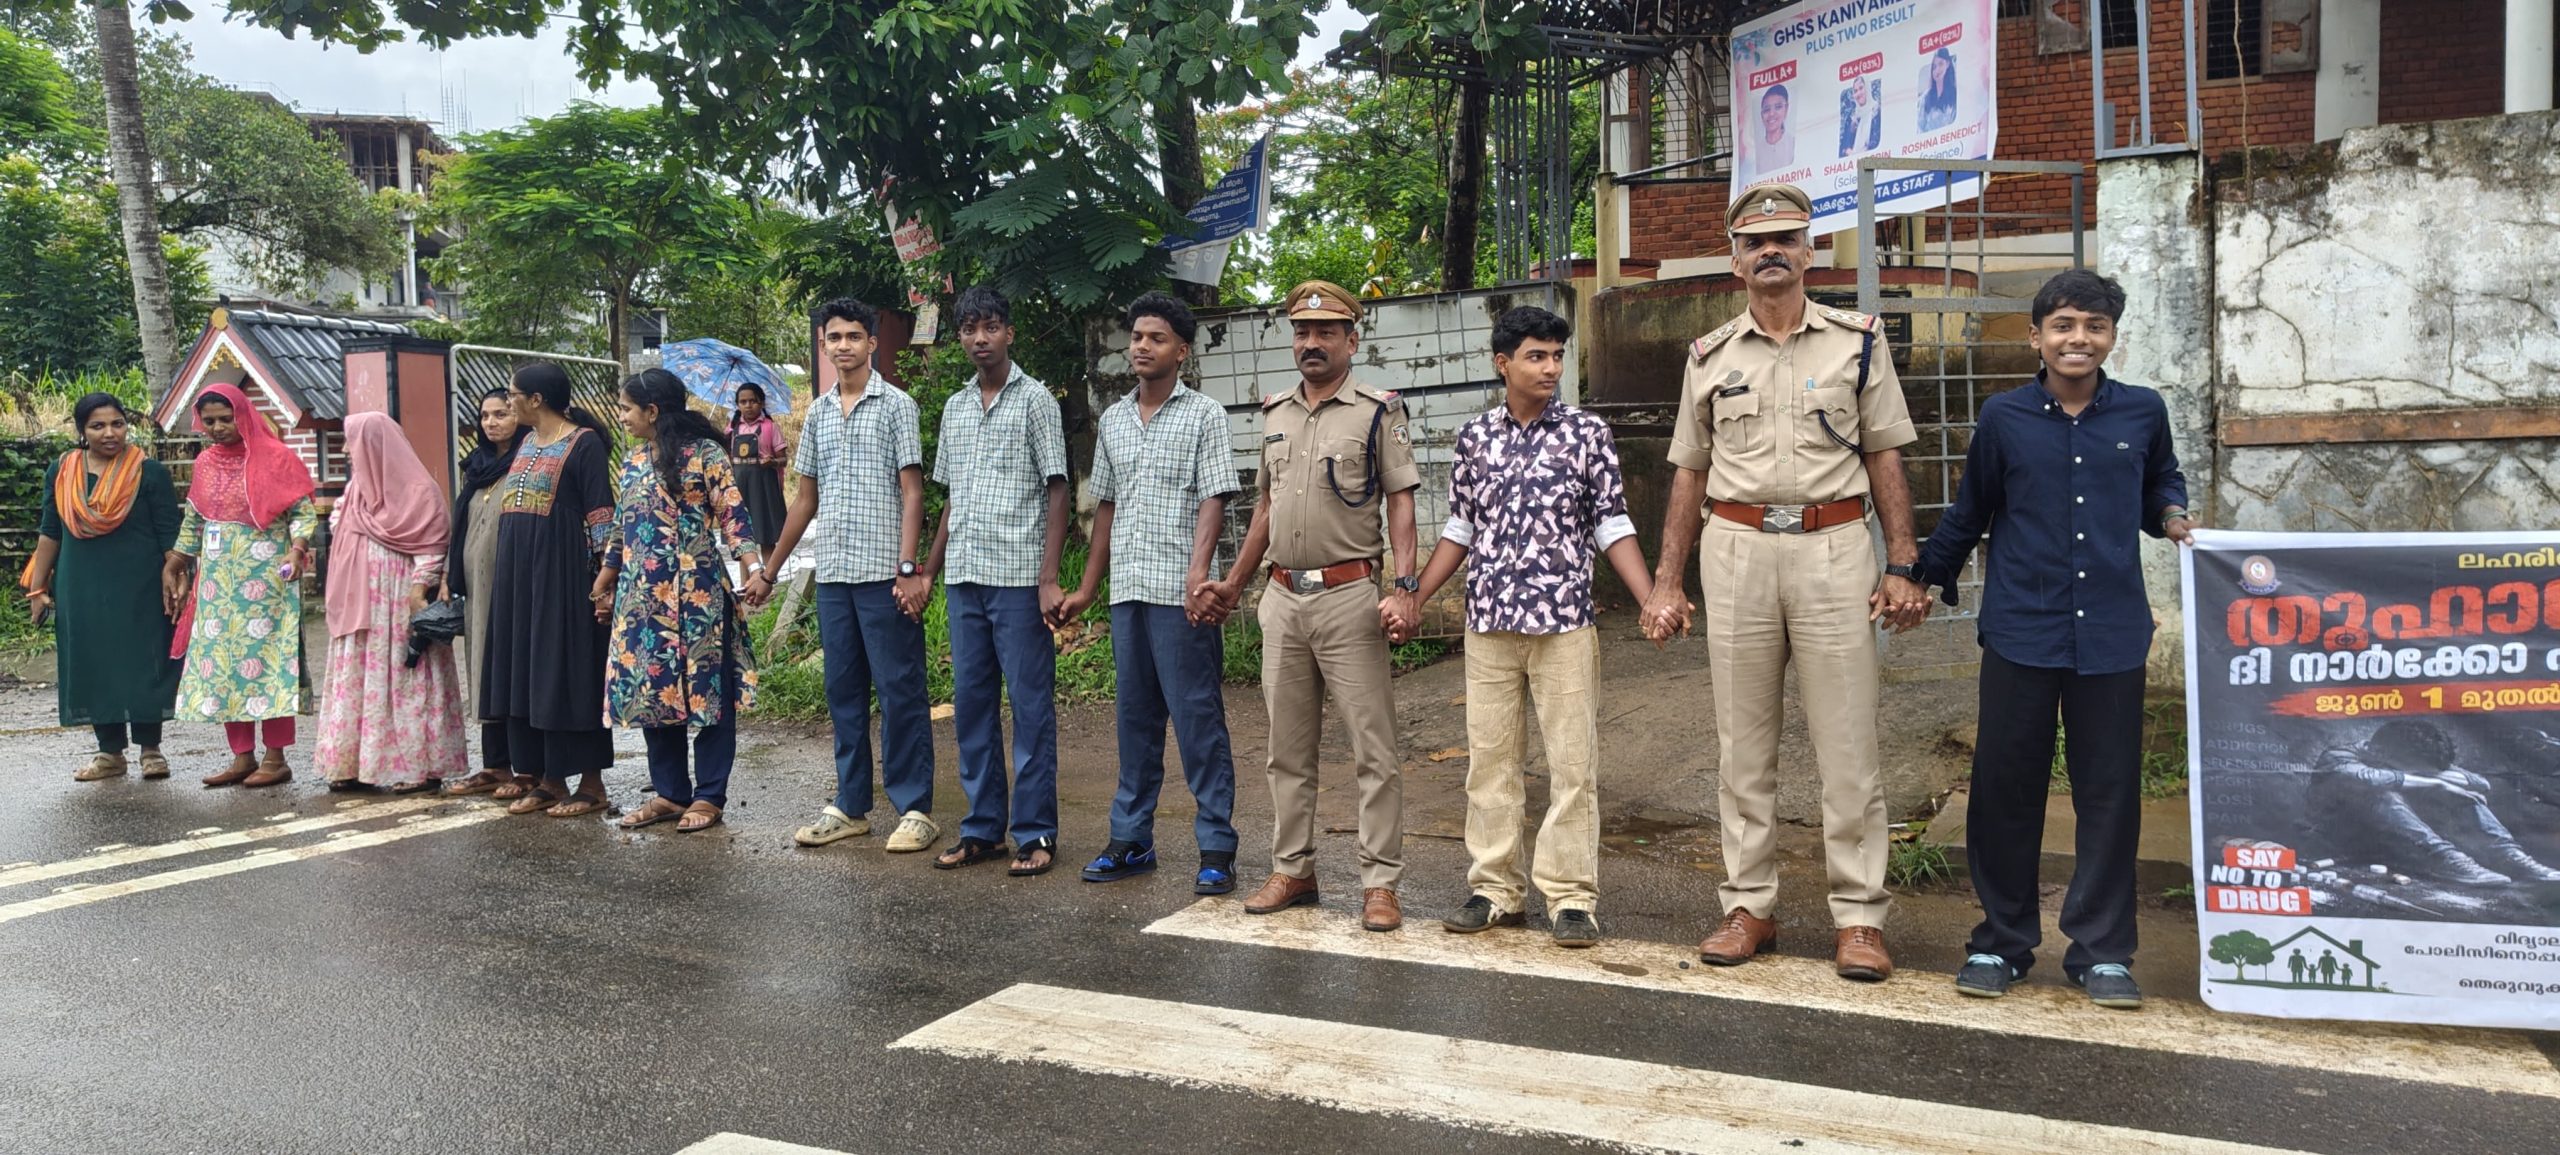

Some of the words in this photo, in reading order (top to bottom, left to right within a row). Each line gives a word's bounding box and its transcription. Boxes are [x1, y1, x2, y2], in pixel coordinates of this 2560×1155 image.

[1774, 18, 1814, 46] GHSS
[1818, 0, 1903, 31] KANIYAM
[1806, 33, 1834, 55] PLUS
[1837, 22, 1867, 43] TWO
[1870, 3, 1916, 32] RESULT
[1753, 69, 1780, 87] FULL
[1780, 65, 1793, 80] A+
[1901, 137, 1938, 155] ROSHNA
[1940, 122, 1982, 144] BENEDICT
[1777, 167, 1812, 184] MARIYA
[1824, 161, 1854, 176] SHALA
[1892, 182, 1900, 194] &
[1902, 173, 1934, 193] STAFF
[2459, 547, 2560, 568] ലഹരി
[2229, 646, 2271, 685] ദി
[2290, 642, 2527, 683] നാർക്കോ
[2315, 689, 2404, 715] ജൂൺ
[2421, 687, 2443, 709] 1
[2461, 683, 2560, 711] മുതൽ
[2205, 739, 2289, 754] ADDICTION
[2237, 848, 2282, 868] SAY
[2211, 864, 2245, 885] NO
[2251, 869, 2282, 889] TO
[2218, 889, 2300, 913] DRUG
